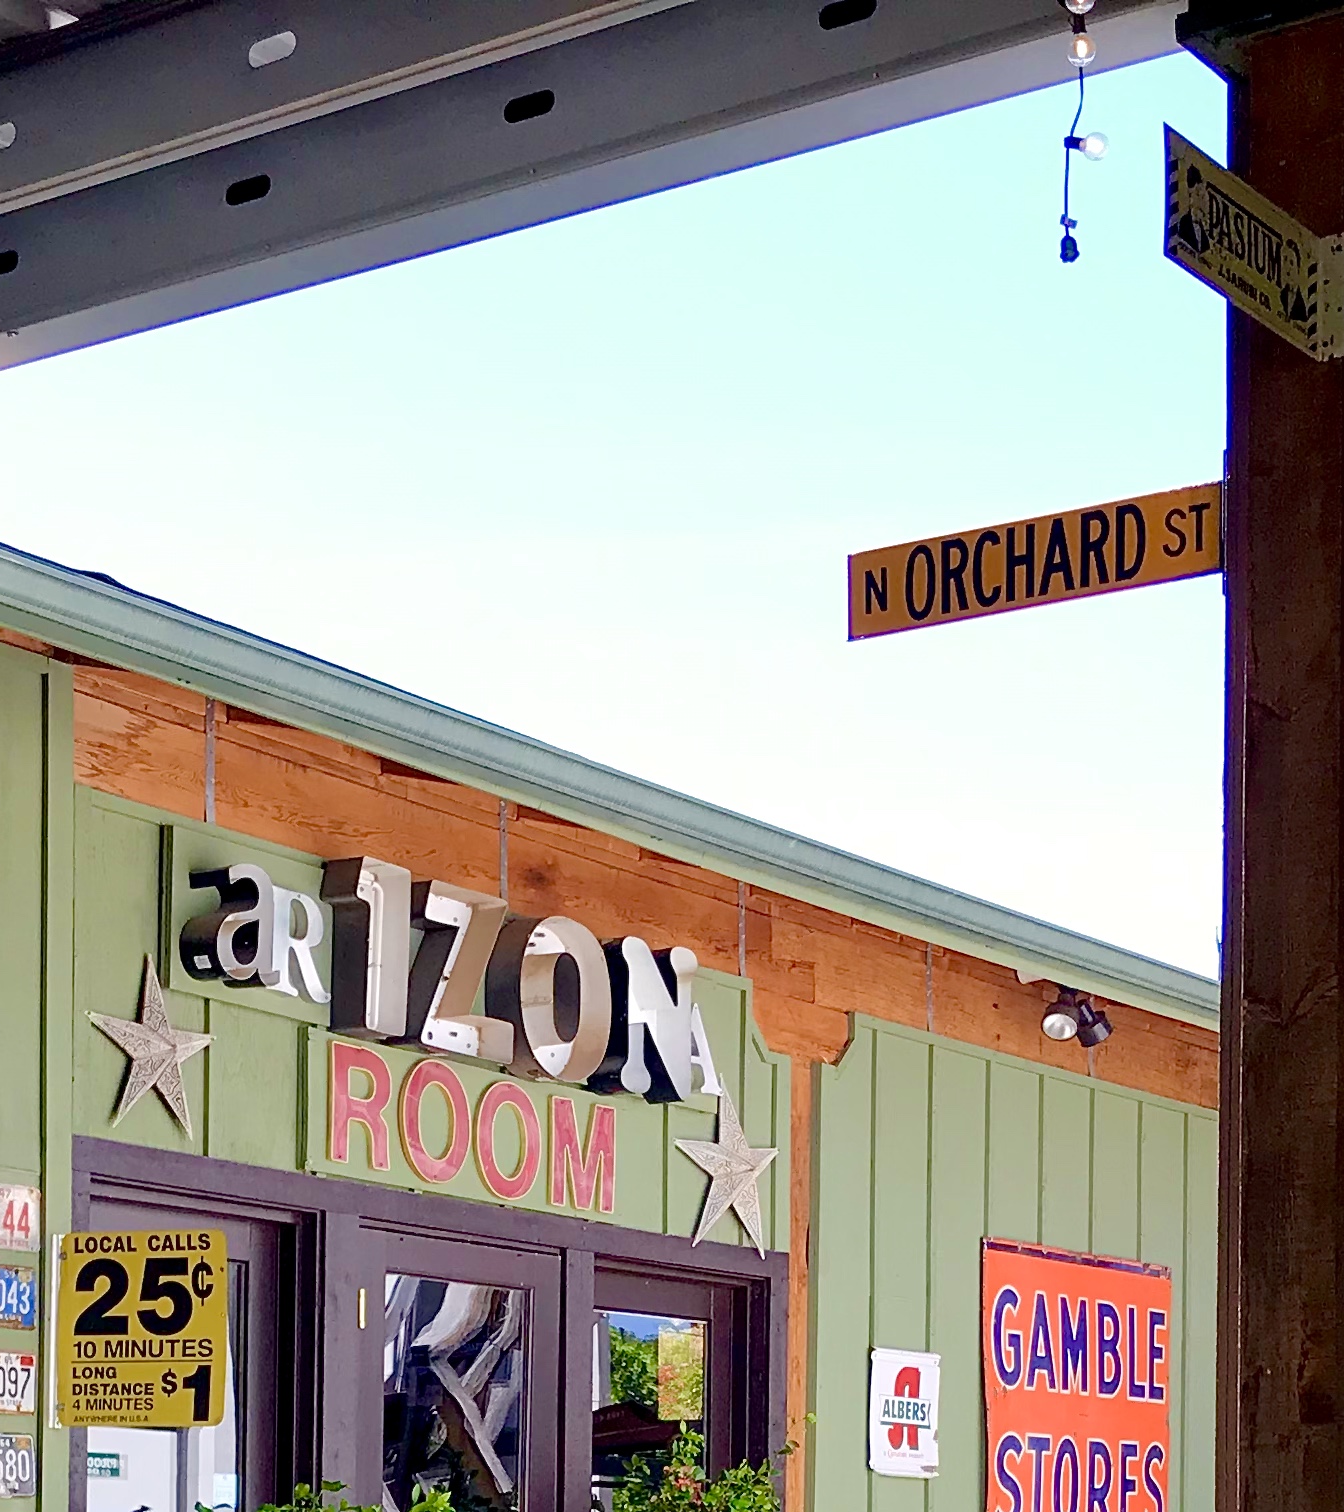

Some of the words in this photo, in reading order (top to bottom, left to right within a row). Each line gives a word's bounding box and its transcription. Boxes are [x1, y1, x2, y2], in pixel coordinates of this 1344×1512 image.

[864, 566, 889, 616] N
[904, 503, 1146, 622] ORCHARD
[1161, 502, 1211, 559] ST
[327, 1040, 617, 1215] ROOM
[73, 1235, 137, 1254] LOCAL
[147, 1232, 211, 1252] CALLS
[72, 1340, 97, 1359] 10
[104, 1338, 213, 1359] MINUTES
[990, 1284, 1168, 1405] GAMBLE
[71, 1366, 117, 1380] LONG
[71, 1382, 154, 1397] DISTANCE
[72, 1400, 81, 1411] 4
[85, 1397, 154, 1411] MINUTES
[882, 1398, 927, 1422] ALBERS
[73, 1414, 119, 1423] ANYWHERE
[119, 1414, 128, 1422] IN
